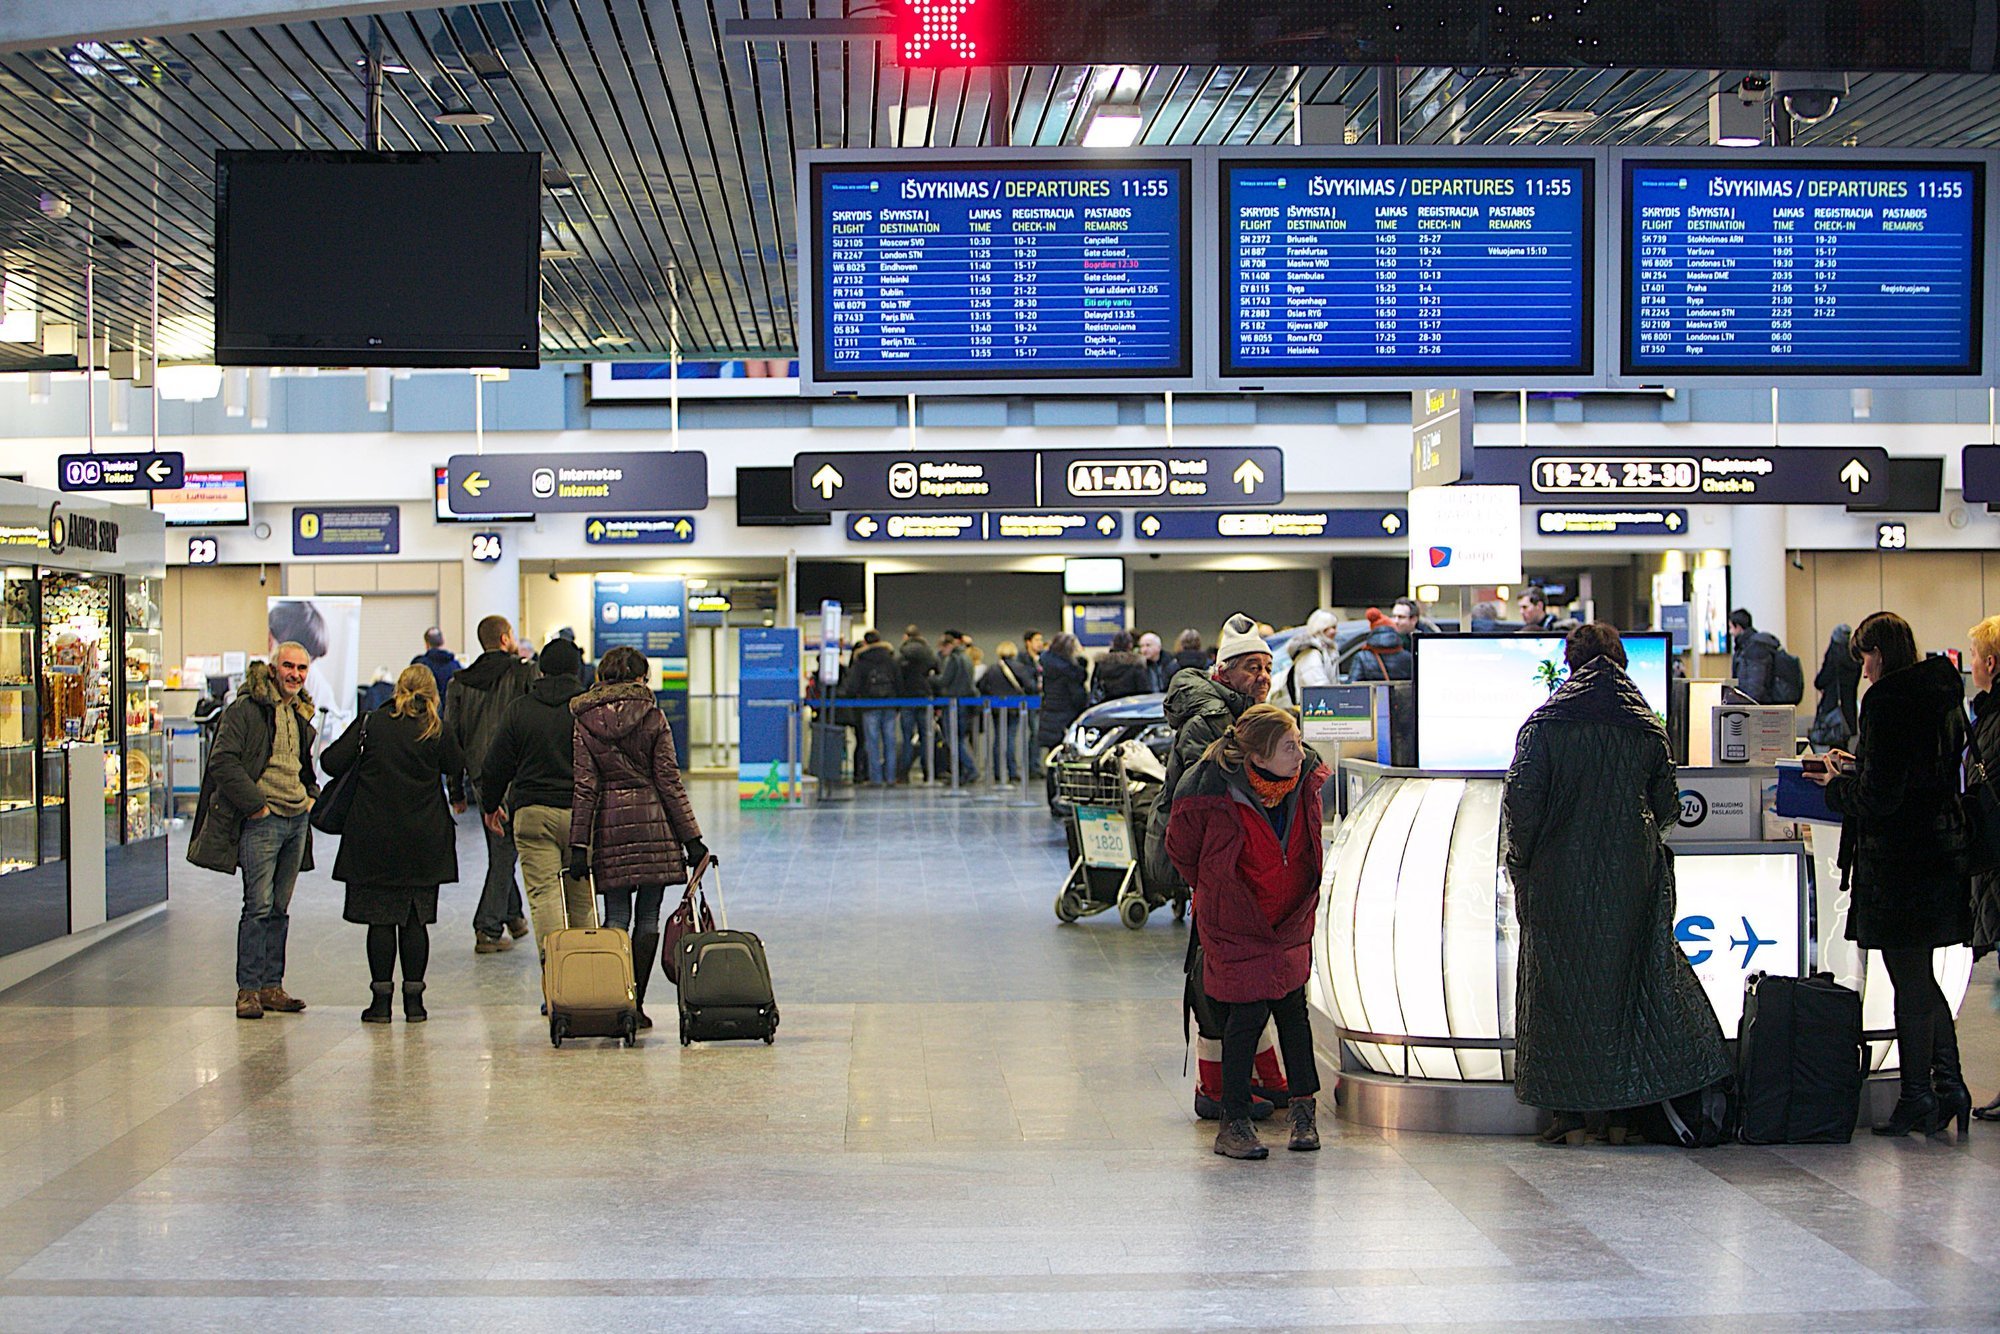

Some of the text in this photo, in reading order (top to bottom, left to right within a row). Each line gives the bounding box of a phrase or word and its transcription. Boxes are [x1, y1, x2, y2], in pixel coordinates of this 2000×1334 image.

[901, 179, 1168, 199] IŠVYKIMAS / DEPARTURES 11:55
[1308, 176, 1571, 197] IŠVYKIMAS / DEPARTURES 11:55
[1708, 177, 1963, 198] IŠVYKIMAS / DEPARTURES 11:55
[833, 211, 872, 221] SKRYDIS
[880, 209, 923, 220] IŠVYKSTA
[969, 209, 1001, 219] LAIKAS
[1013, 209, 1074, 219] REGISTRACIJA
[1085, 208, 1131, 218] PASTABOS
[1240, 207, 1279, 217] SKRYDIS
[1287, 205, 1330, 217] IŠVYKSTA
[1376, 207, 1407, 216] LAIKAS
[1418, 207, 1479, 217] REGISTRACIJA
[1489, 207, 1535, 216] PASTABOS
[1642, 207, 1680, 217] SKRYDIS
[1688, 206, 1729, 217] IŠVYKSTA
[1773, 208, 1804, 217] LAIKAS
[1815, 208, 1873, 219] REGISTRACIJA
[1883, 209, 1927, 218] PASTABOS
[833, 221, 1128, 233] FLIGHT DESTINATION TIME CHECK-IN REMARKS
[1241, 220, 1531, 230] FLIGHT DESTINATION TIME CHECK-IN REMARKS
[1642, 220, 1923, 230] FLIGHT DESTINATION TIME CHECK-IN REMARKS
[833, 239, 842, 247] SU
[844, 238, 863, 247] 2105
[880, 238, 909, 246] Moscow
[911, 237, 924, 246] SVO
[970, 237, 990, 245] 10:30
[1015, 236, 1036, 245] 10-12
[1376, 234, 1441, 242] 14:05 25-27
[1774, 235, 1836, 243] 18:15 19-20
[833, 251, 842, 259] FR
[844, 251, 862, 259] 2247
[880, 251, 907, 259] London
[909, 250, 922, 258] STN
[970, 250, 990, 258] 11:25
[1015, 249, 1036, 257] 19-20
[1376, 247, 1441, 255] 14:20 19-24
[880, 263, 917, 271] Eindhoven
[833, 274, 1036, 284] AY 2132 11:45 25-27
[1287, 271, 1441, 280] Stambulas 15:00 10-13
[881, 286, 1036, 296] Dublin 11:50 21-22
[1287, 284, 1431, 294] Ryga 15:25 3-4
[1687, 284, 1826, 292] Praha 21:05 5-7
[898, 300, 911, 308] TRF
[971, 299, 991, 307] 12:45
[1014, 299, 1037, 307] 28-30
[1376, 296, 1440, 304] 15:50 19-21
[971, 311, 1037, 320] 13:15 19-20
[1376, 309, 1396, 317] 16:50
[881, 325, 905, 333] Vienna
[971, 324, 991, 332] 13:40
[1376, 321, 1440, 329] 16:50 15-17
[1015, 336, 1027, 344] 5-7
[1376, 333, 1441, 341] 17:25 28-30
[881, 348, 1037, 358] Warsaw 13:55 15-17
[1419, 345, 1441, 353] 25-26
[558, 469, 622, 481] Internetas
[1073, 466, 1161, 490] A1-A14
[1542, 463, 1691, 488] 19-24, 25-30
[920, 481, 989, 497] Departures
[1702, 478, 1755, 492] Check-in
[558, 484, 609, 497] Internet
[1879, 526, 1906, 548] 25
[472, 536, 501, 560] 24
[620, 605, 680, 619] FAST TRACK
[1096, 836, 1123, 851] 1820
